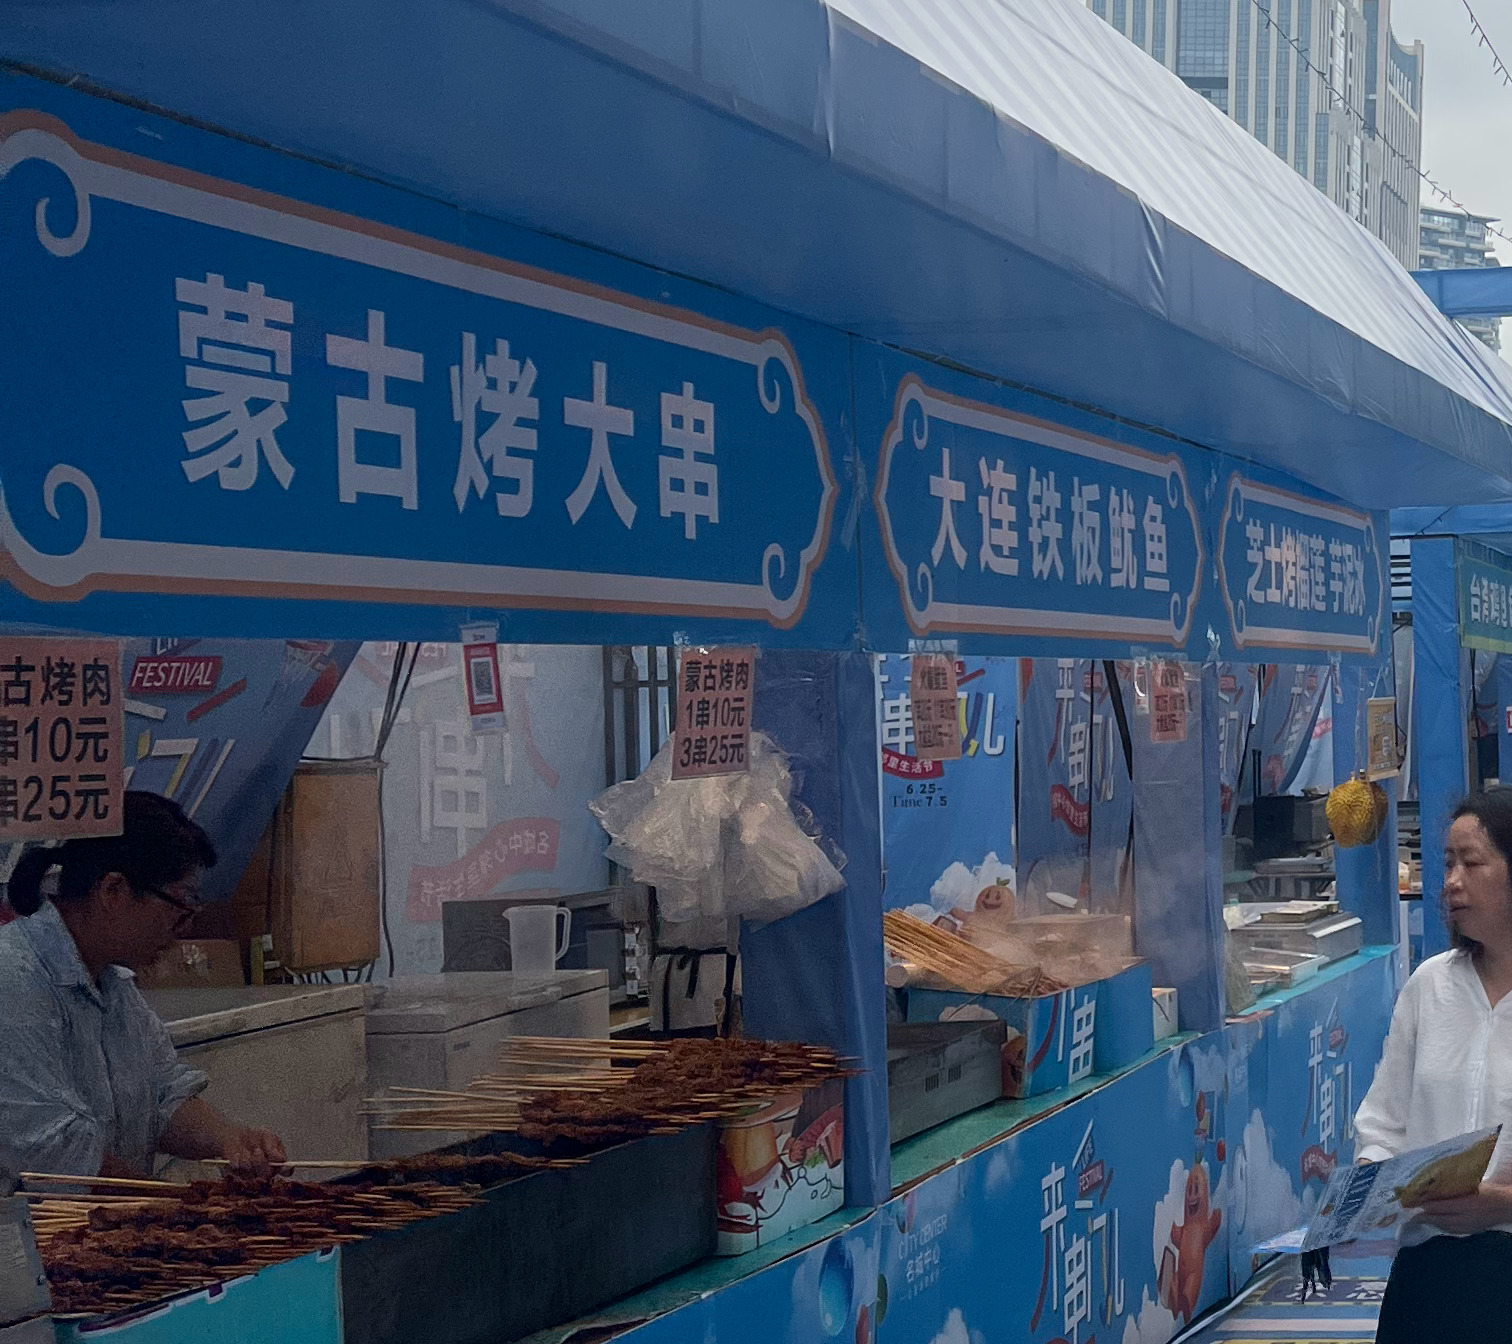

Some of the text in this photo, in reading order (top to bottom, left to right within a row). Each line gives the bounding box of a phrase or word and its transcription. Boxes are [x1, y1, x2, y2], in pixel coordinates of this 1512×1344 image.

[174, 273, 720, 541] 蒙古烤大串
[929, 448, 1171, 593] 大连铁板鱿鱼
[1, 656, 112, 707] 古烤肉
[132, 660, 216, 689] FESTIVAL
[685, 660, 749, 693] 蒙古烤肉
[685, 698, 747, 729] 1串10元
[679, 735, 745, 769] 3串25元
